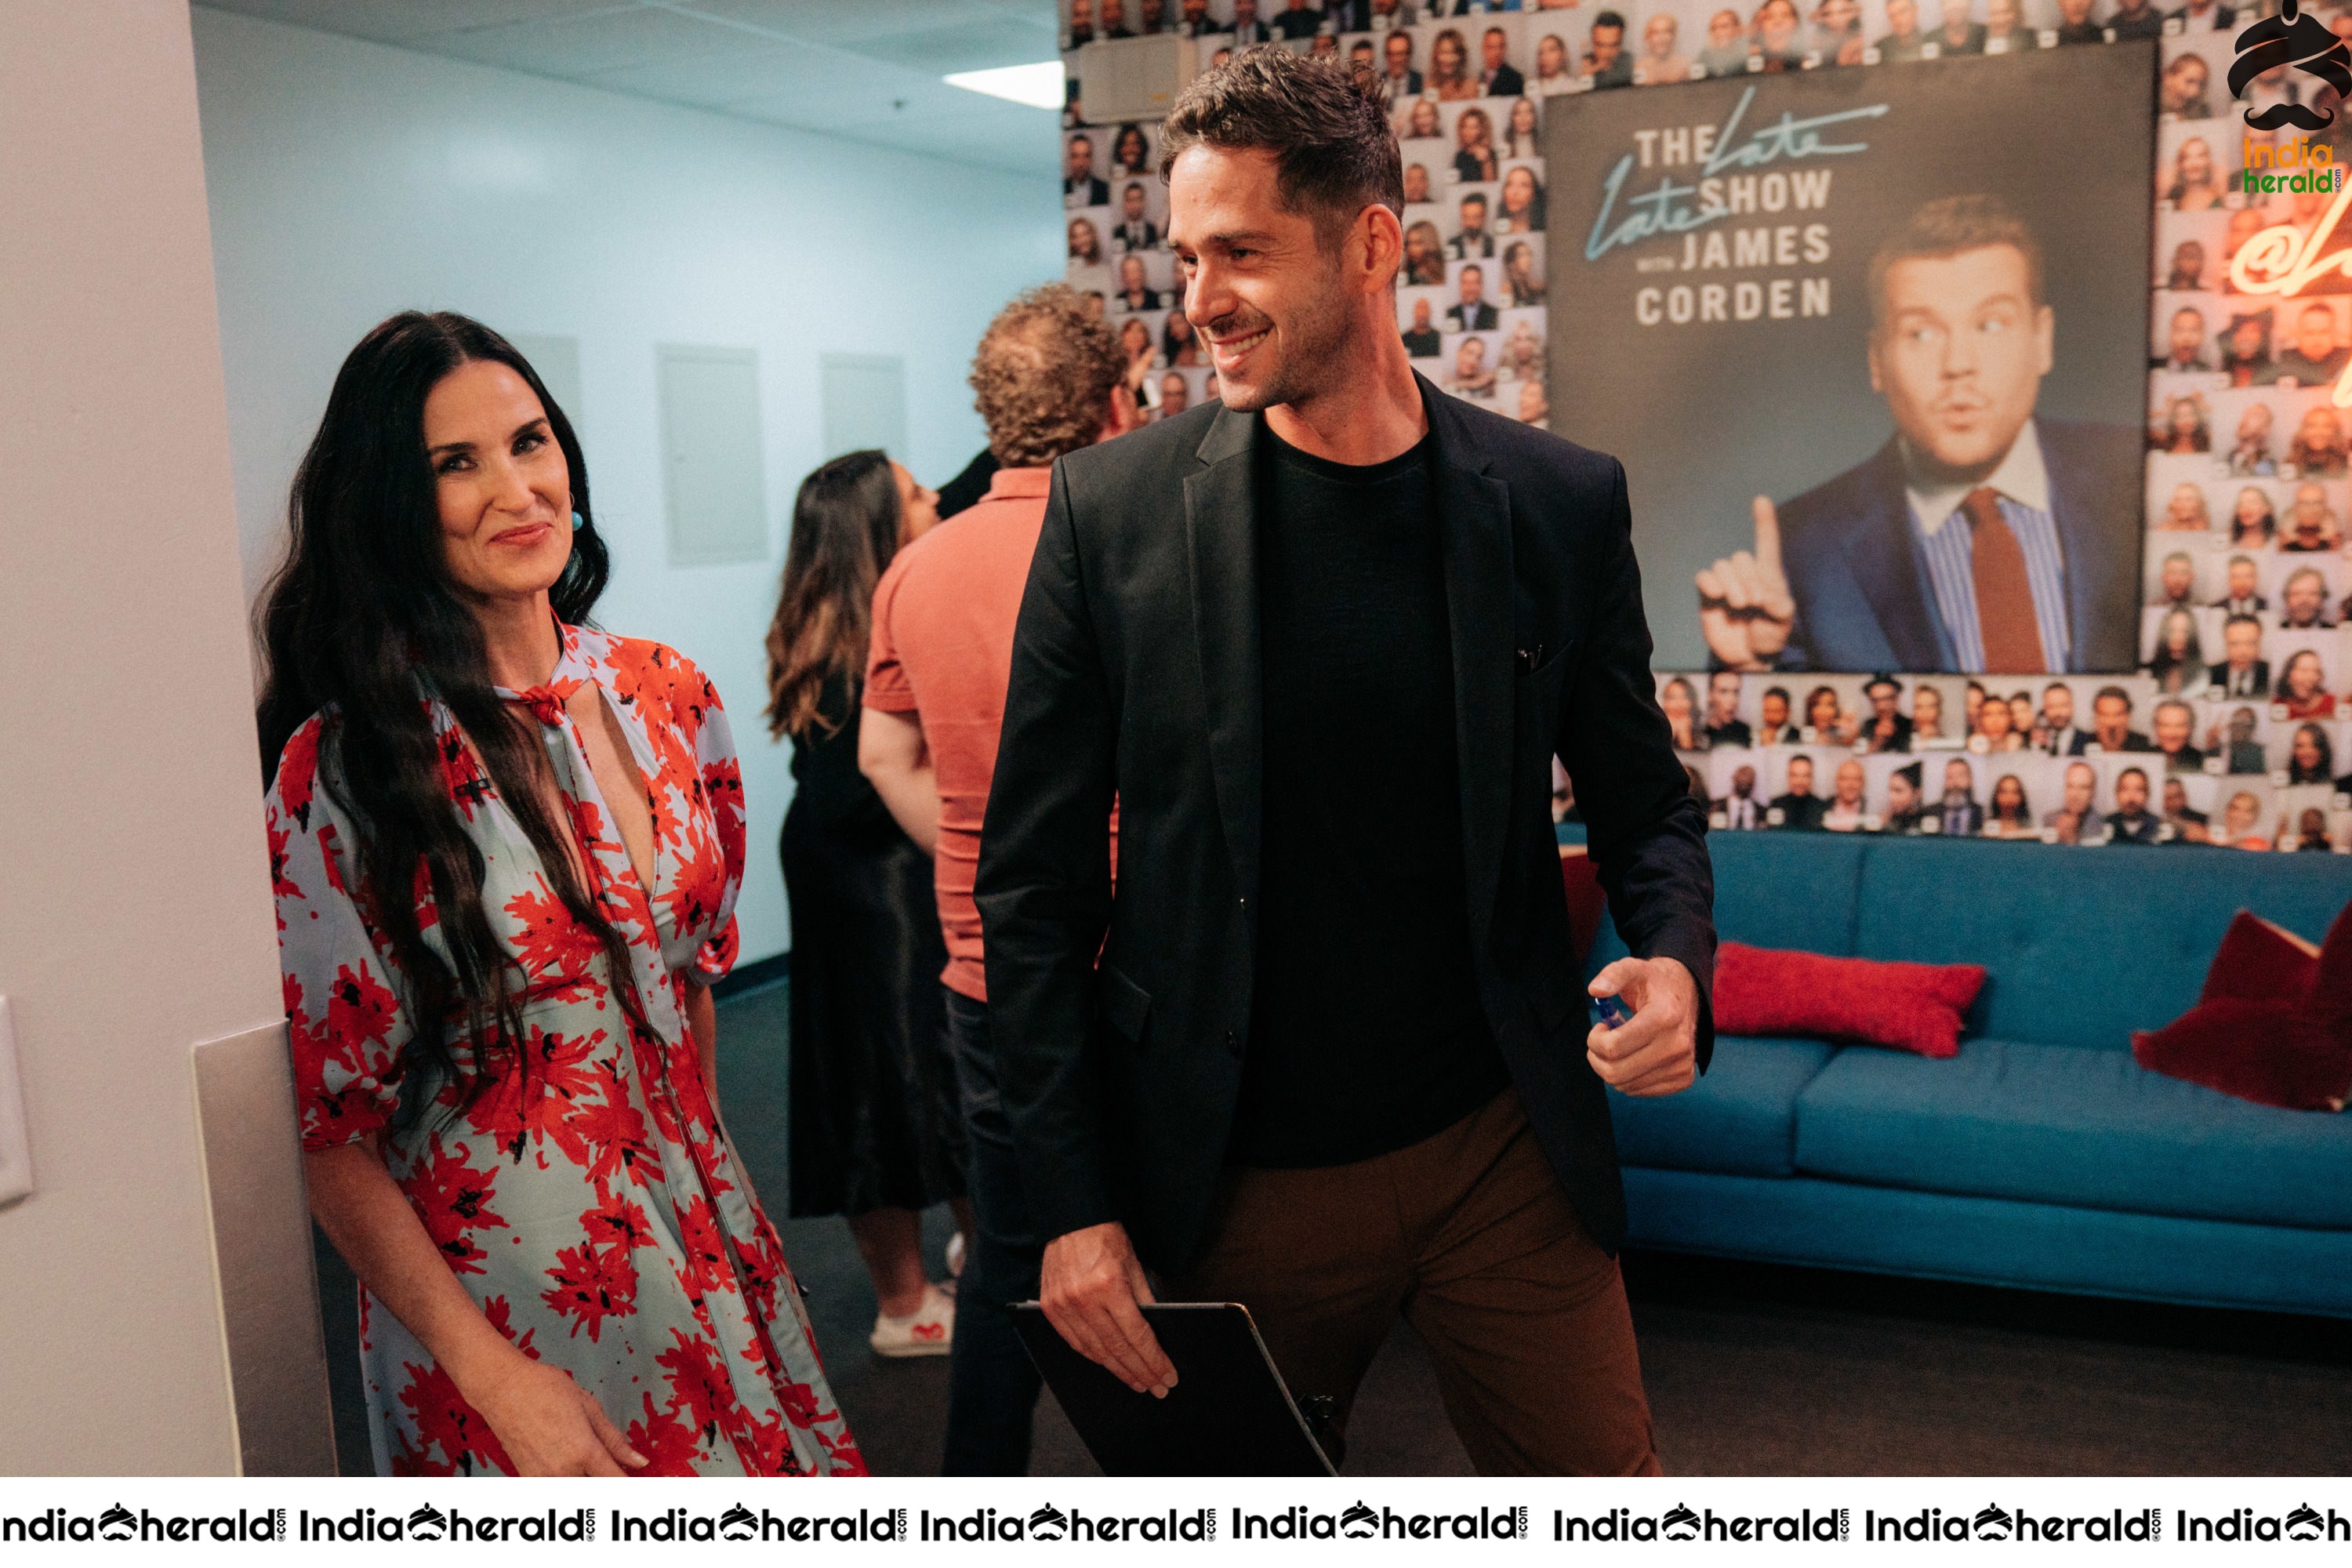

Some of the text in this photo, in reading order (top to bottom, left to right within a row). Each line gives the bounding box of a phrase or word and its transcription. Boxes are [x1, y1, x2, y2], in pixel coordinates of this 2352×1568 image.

[1634, 85, 1889, 176] THE Late
[1585, 155, 1832, 262] Late SHOW
[1681, 223, 1831, 271] JAMES
[1636, 278, 1831, 326] CORDEN
